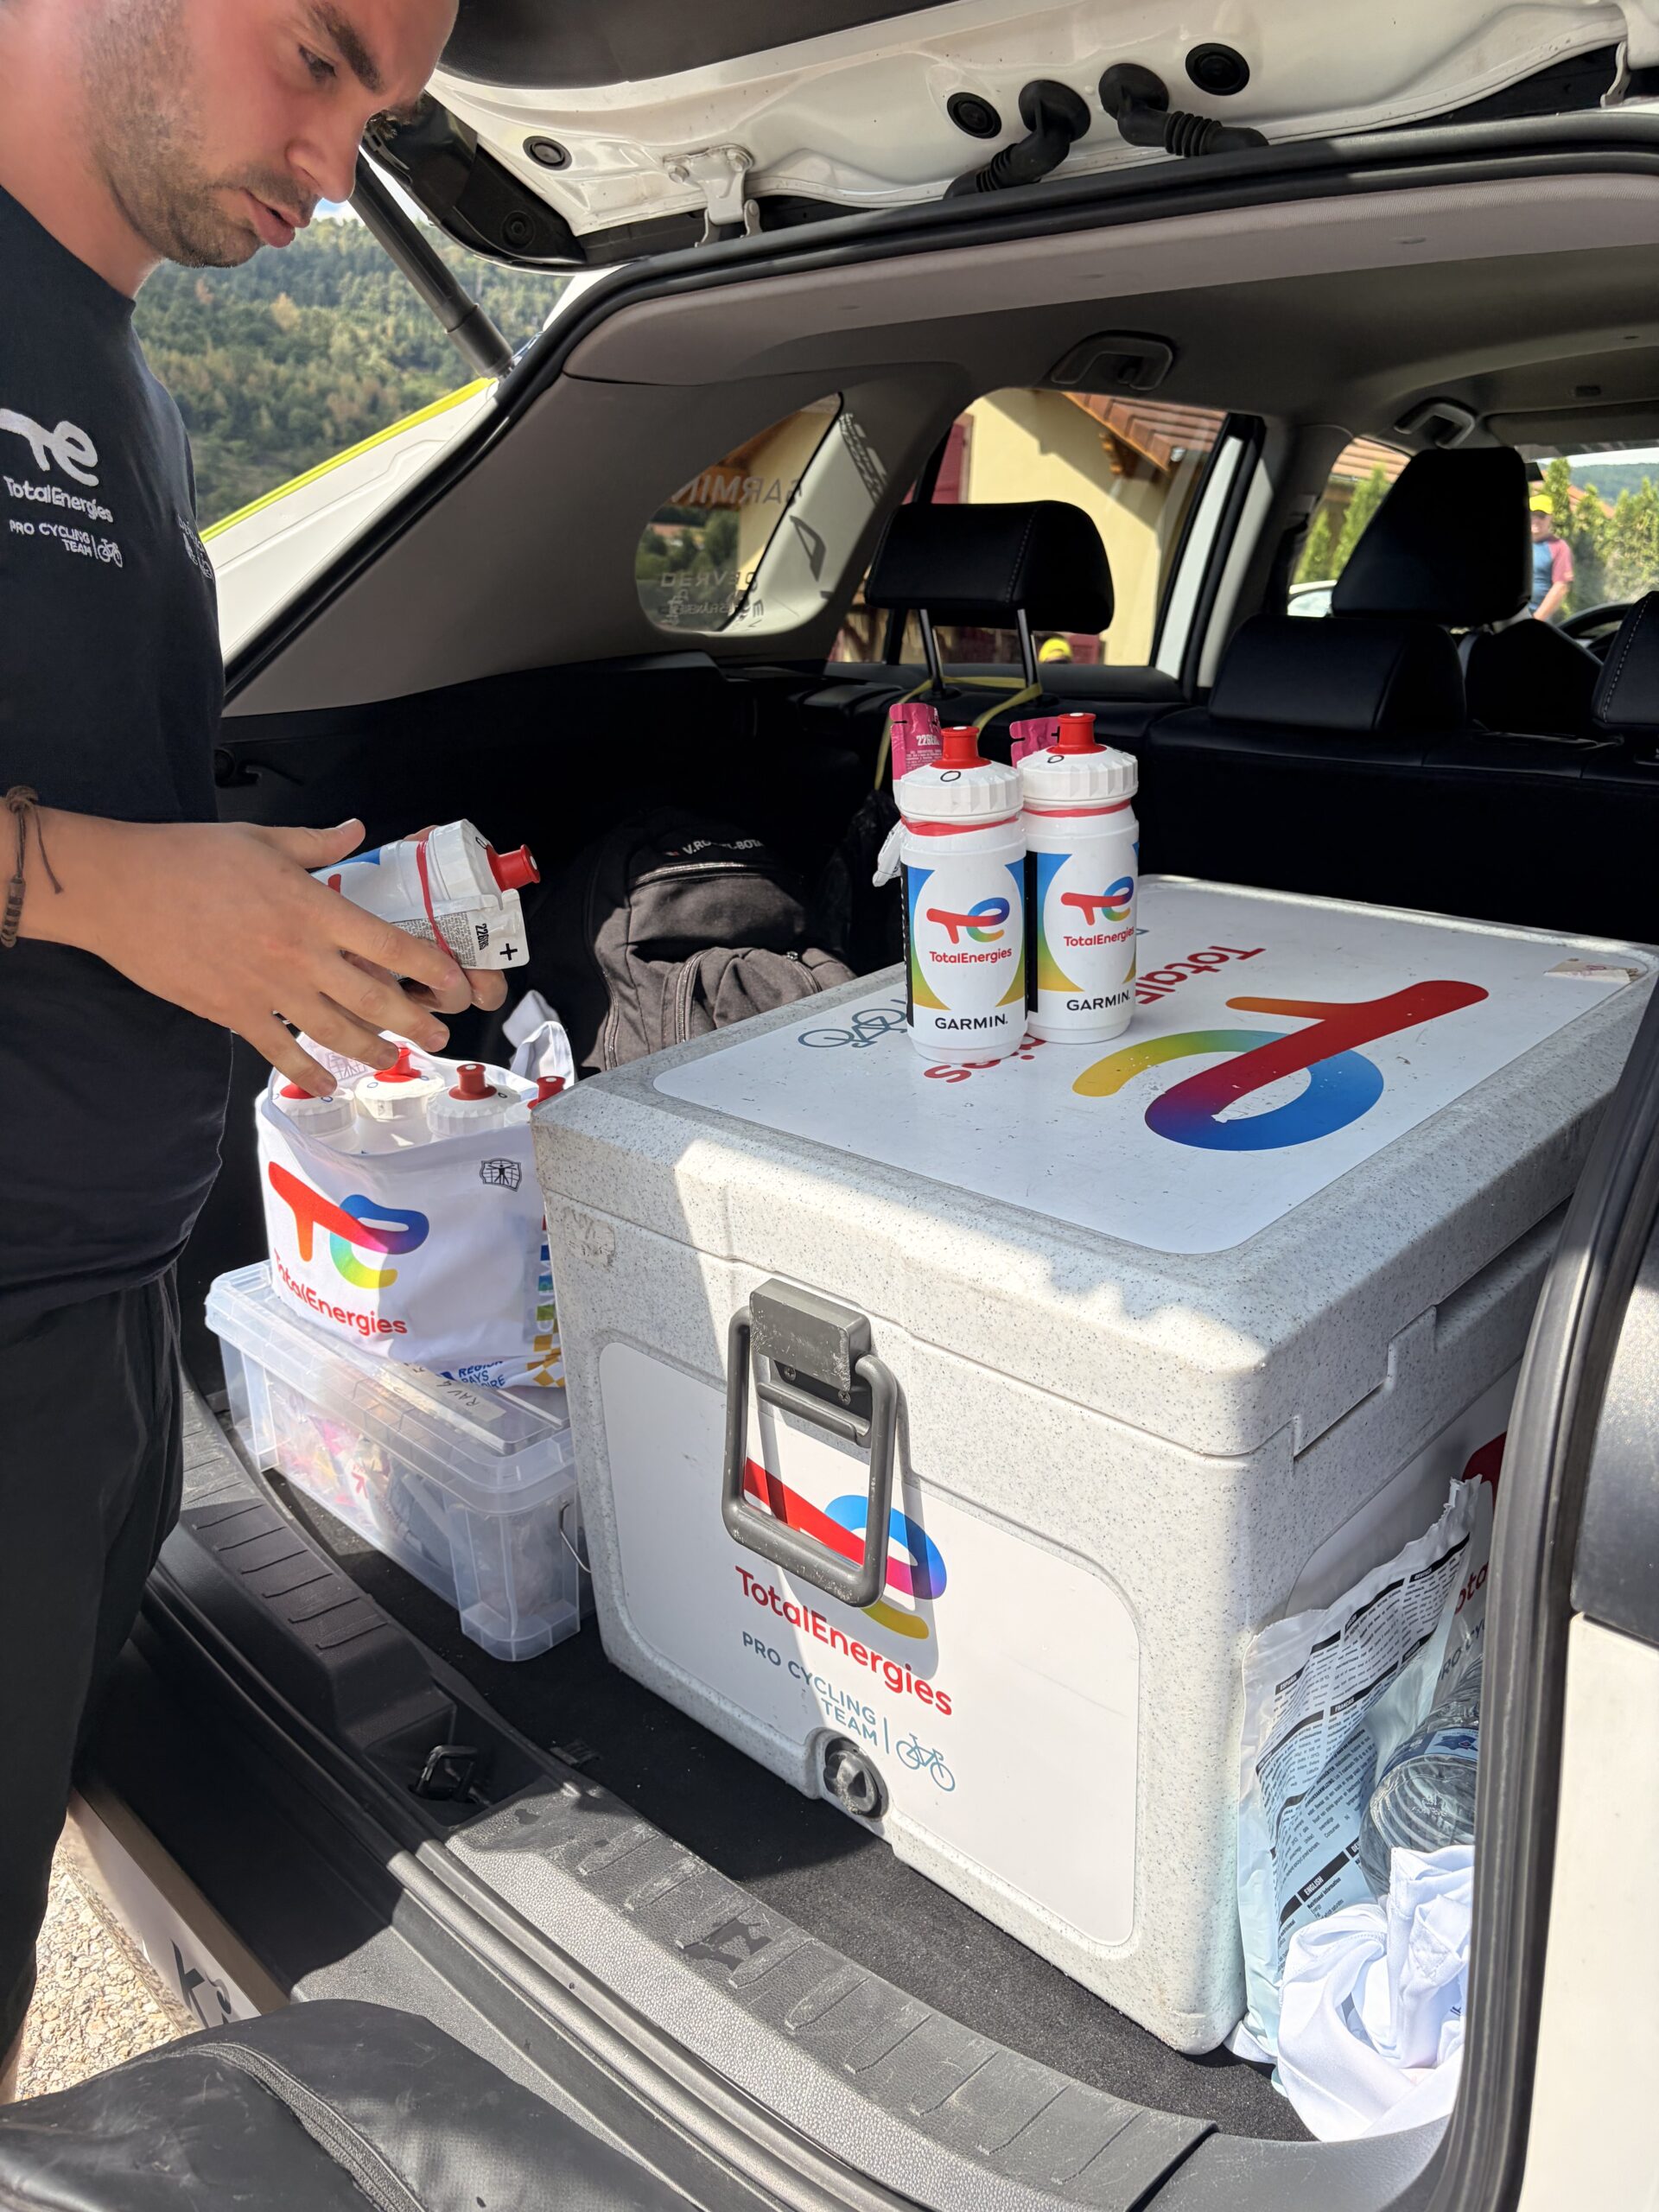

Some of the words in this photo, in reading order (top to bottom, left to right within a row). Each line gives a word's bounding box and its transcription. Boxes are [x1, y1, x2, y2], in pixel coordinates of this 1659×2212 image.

[4, 476, 113, 523] TotalEnergies
[10, 519, 35, 535] PRO
[39, 523, 90, 543] CYCLING
[63, 538, 92, 557] TEAM
[1064, 926, 1135, 947] TotalEnergies
[929, 946, 1013, 964] TotalEnergies
[735, 1566, 953, 1716] TotalEnergies
[742, 1630, 781, 1667] PRO
[788, 1659, 876, 1726] CYCLING
[821, 1698, 878, 1746] TEAM
[1304, 1876, 1324, 1896] ENGLISH
